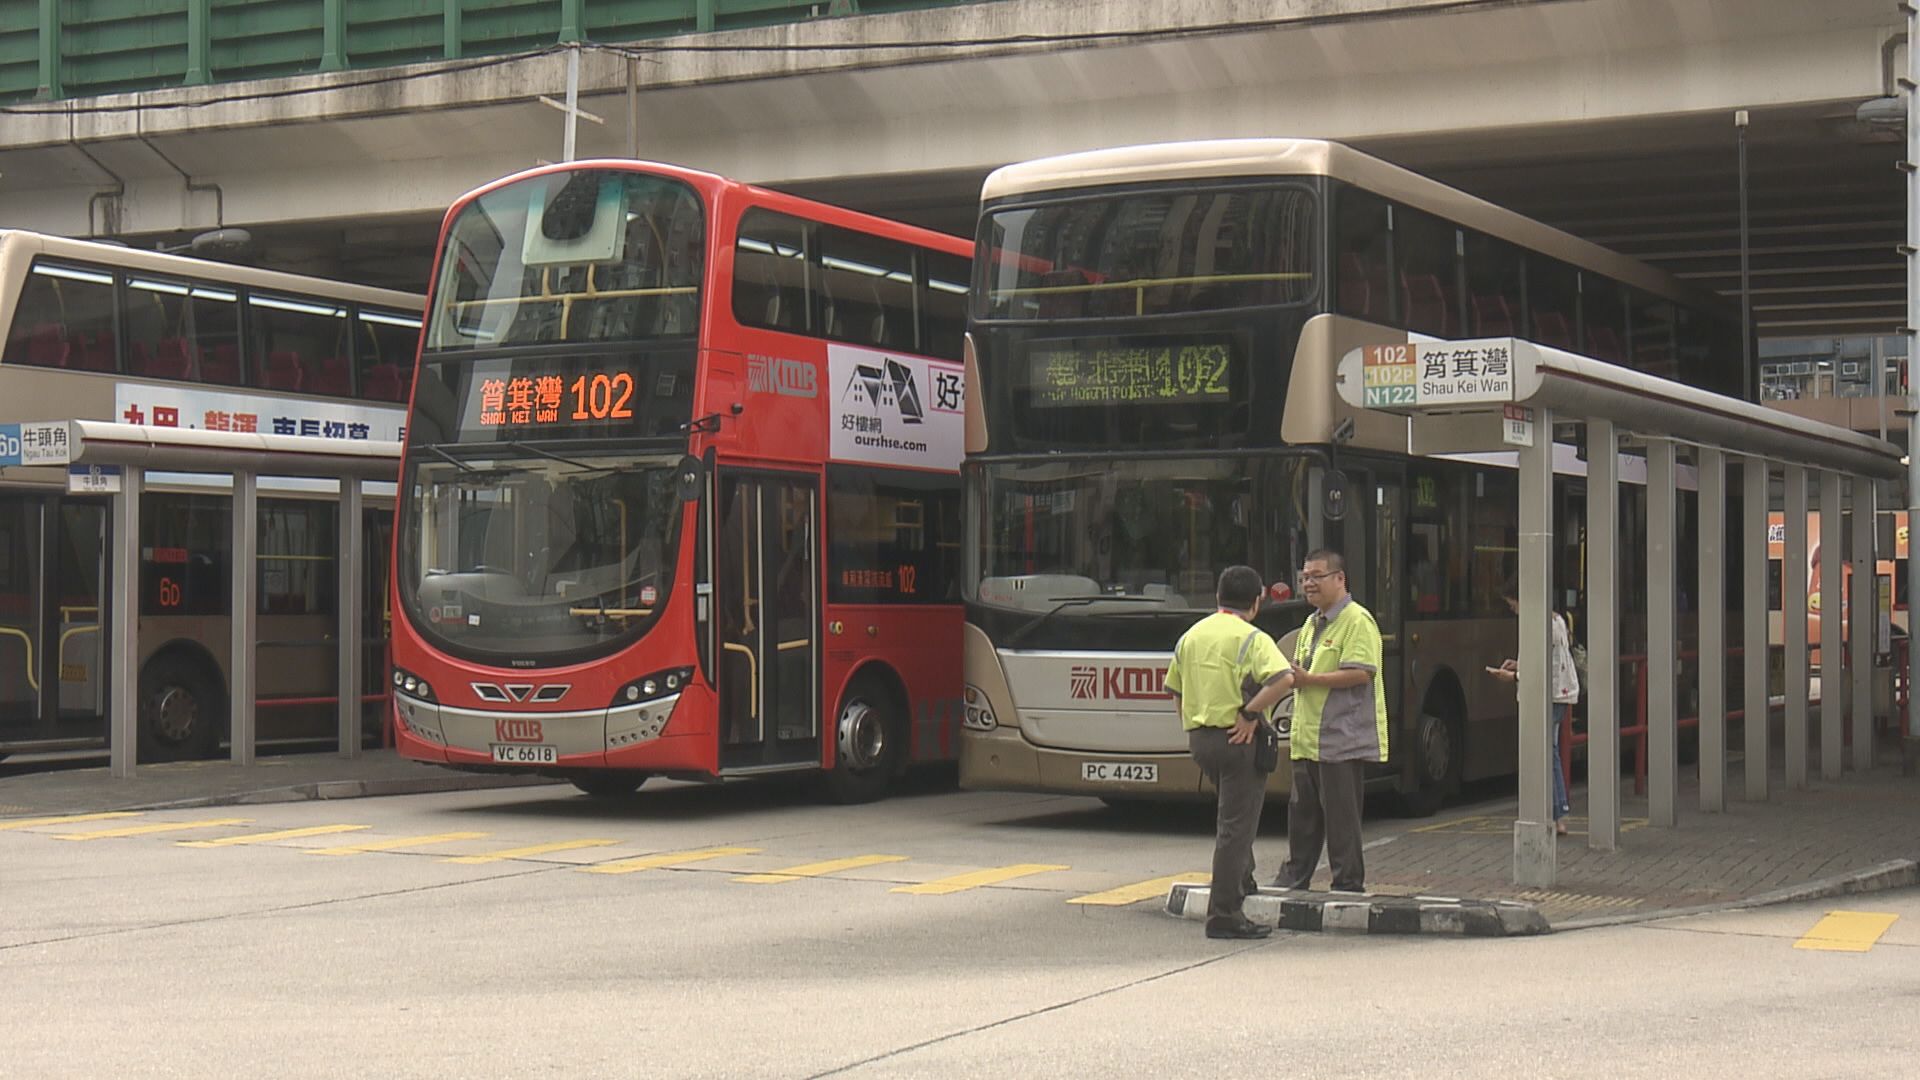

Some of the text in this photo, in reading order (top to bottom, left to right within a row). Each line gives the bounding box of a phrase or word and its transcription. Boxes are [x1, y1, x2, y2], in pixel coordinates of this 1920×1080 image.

[1374, 346, 1407, 364] 102
[1423, 347, 1508, 379] 筲箕灣
[769, 357, 818, 397] KMB
[1156, 345, 1230, 396] 102
[1369, 366, 1413, 384] 102P
[480, 373, 633, 420] 筲箕灣 102
[936, 371, 964, 410] 好
[1367, 386, 1415, 405] N122
[1423, 379, 1508, 396] Shau Kei Wan
[480, 409, 558, 425] SHAU KEI WAN
[842, 414, 882, 434] 好樓網
[0, 433, 19, 457] 6D
[24, 427, 67, 447] 牛頭角
[855, 434, 927, 453] ourshse.com
[898, 565, 917, 593] 102
[160, 577, 180, 607] 6D
[495, 719, 544, 743] KMB
[498, 747, 552, 761] VC 6618
[1087, 765, 1154, 780] PC 4423
